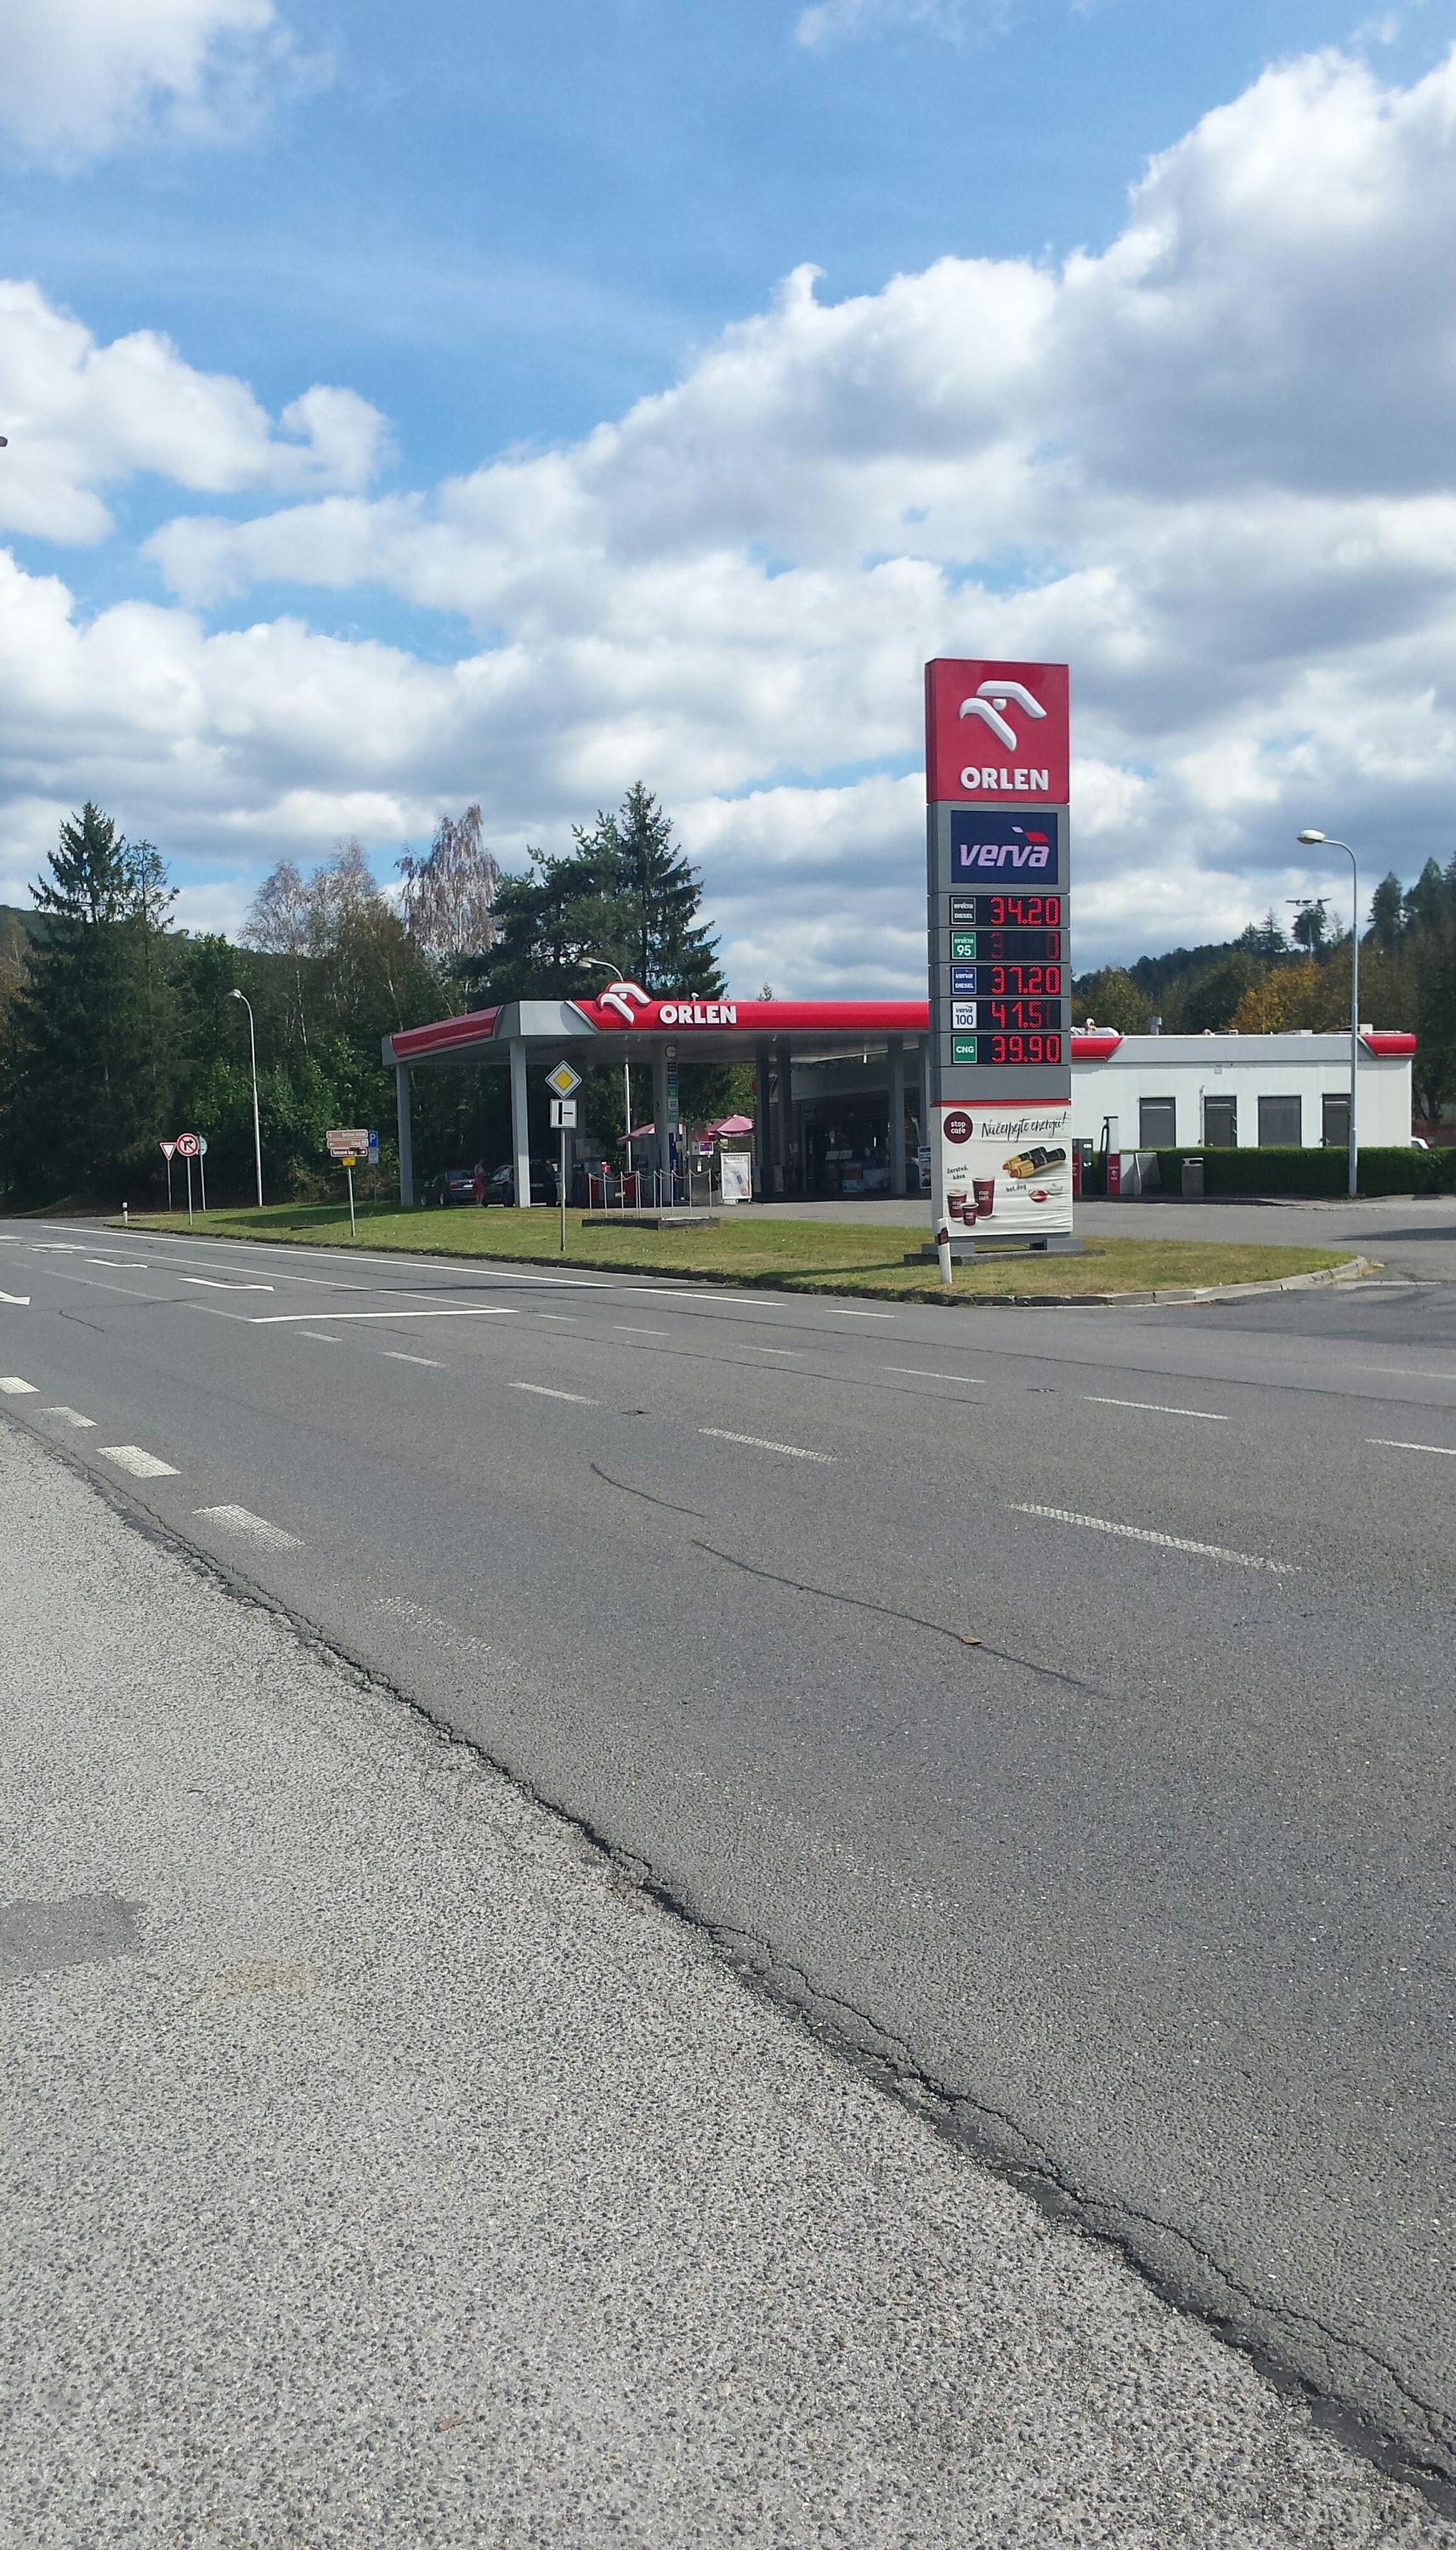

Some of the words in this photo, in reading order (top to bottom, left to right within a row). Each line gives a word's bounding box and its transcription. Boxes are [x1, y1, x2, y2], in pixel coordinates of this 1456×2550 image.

[960, 767, 1049, 790] ORLEN
[960, 844, 1050, 868] verva
[990, 897, 1059, 925] 34.20
[956, 945, 972, 956] 95
[991, 966, 1060, 994] 37.20
[660, 1005, 737, 1024] ORLEN
[955, 1015, 974, 1025] 100
[991, 1035, 1060, 1062] 39.90
[950, 1120, 966, 1129] stop
[370, 1133, 376, 1143] P
